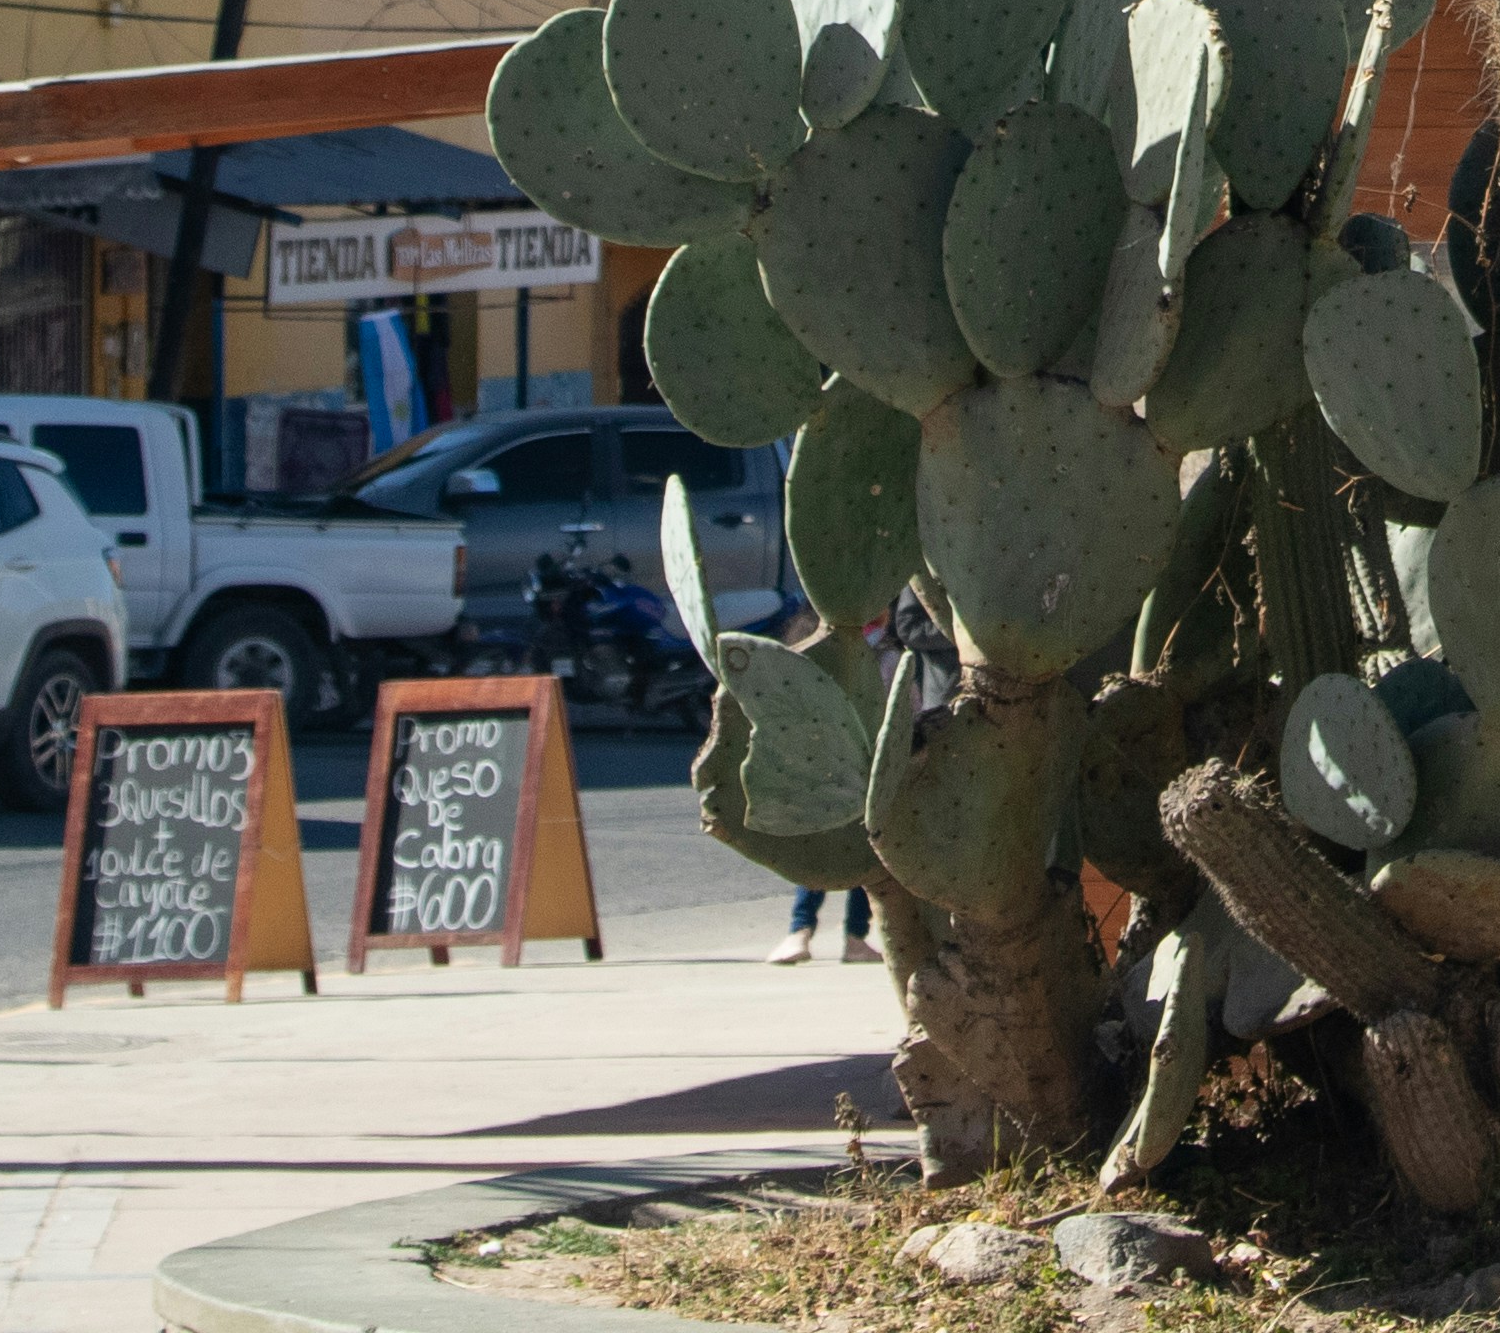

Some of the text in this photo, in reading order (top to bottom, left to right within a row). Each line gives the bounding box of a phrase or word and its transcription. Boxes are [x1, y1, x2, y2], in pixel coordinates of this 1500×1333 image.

[276, 235, 376, 285] TIENDA
[495, 226, 593, 271] TIENDA
[395, 717, 501, 758] Promo
[393, 759, 501, 806] Queso
[393, 827, 503, 874] Cabra
[94, 877, 227, 921] Cayote
[384, 871, 499, 933] $600
[91, 910, 221, 964] $1100
